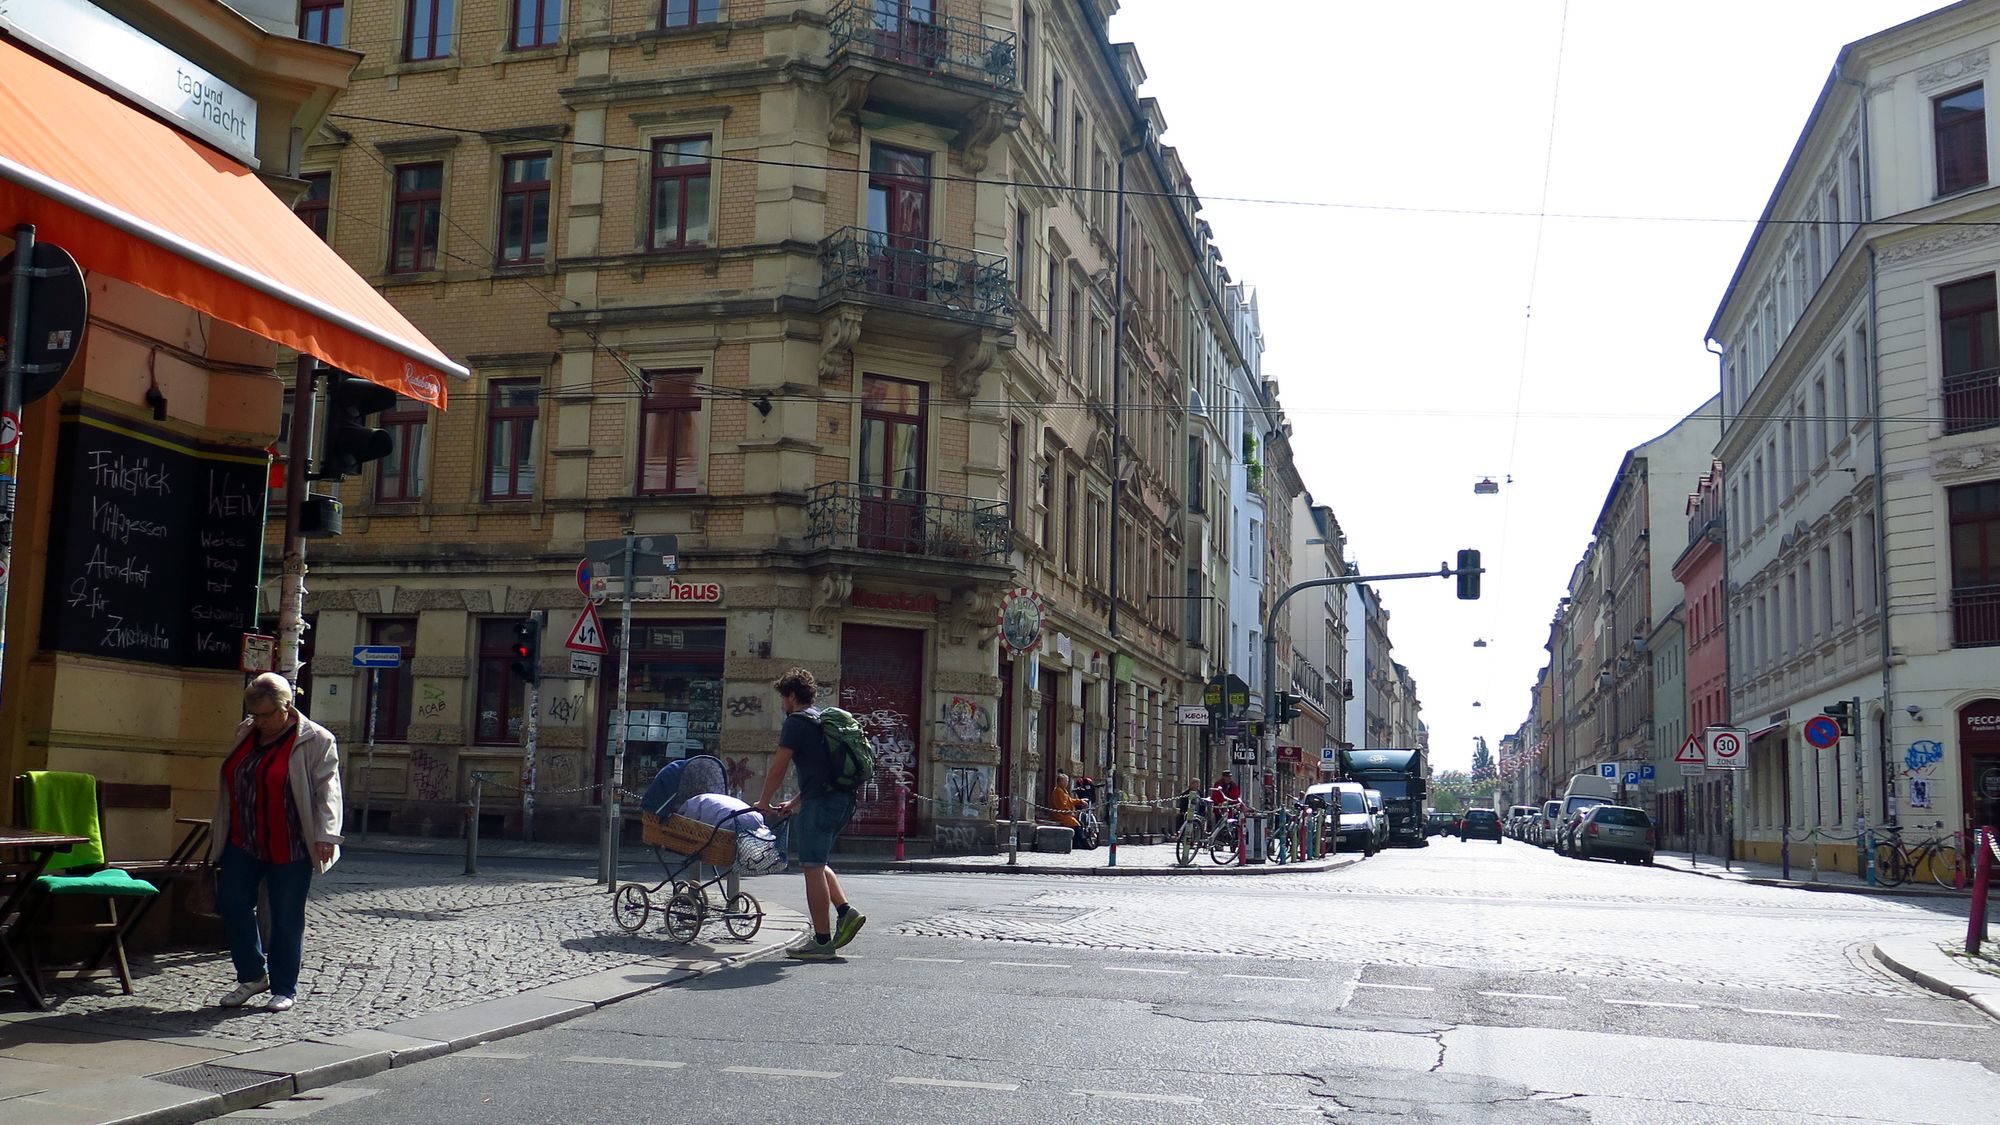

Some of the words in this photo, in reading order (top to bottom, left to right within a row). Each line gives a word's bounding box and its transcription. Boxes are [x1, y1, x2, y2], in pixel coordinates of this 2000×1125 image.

[177, 67, 202, 105] tag
[205, 86, 223, 105] und
[203, 101, 246, 140] nacht
[88, 451, 170, 496] Frühstück
[93, 496, 167, 544] Mittagessen
[85, 544, 151, 588] Abendbrot
[418, 700, 447, 717] ACAB
[1719, 740, 1735, 751] 30
[1604, 765, 1613, 776] P
[1628, 772, 1636, 782] P
[1642, 766, 1652, 777] P
